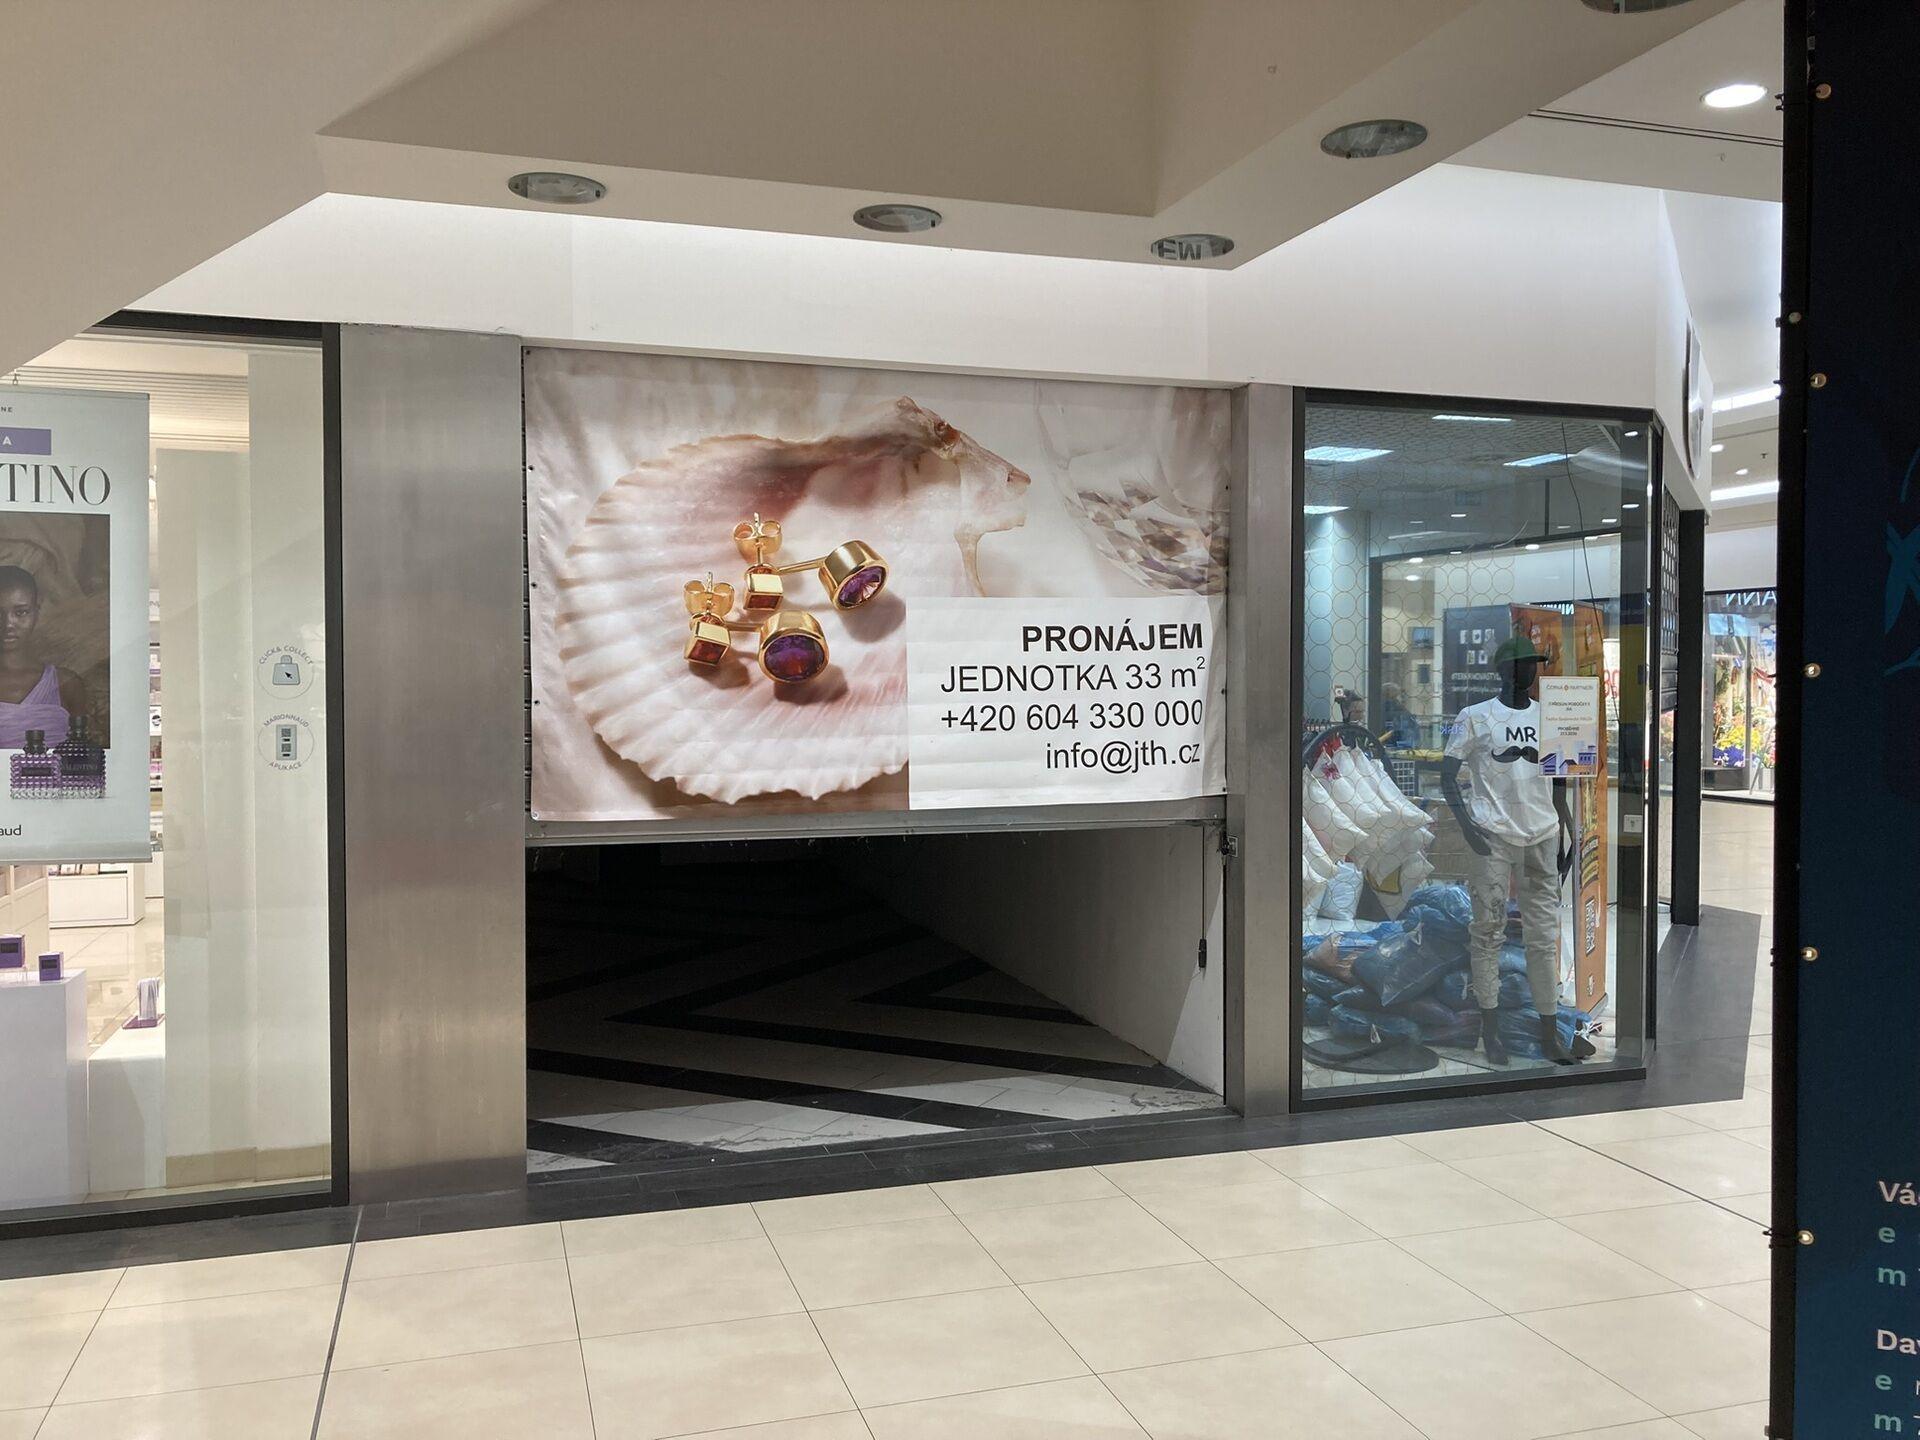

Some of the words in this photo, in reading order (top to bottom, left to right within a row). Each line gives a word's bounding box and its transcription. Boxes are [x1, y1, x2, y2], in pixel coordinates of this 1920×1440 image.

[0, 463, 111, 506] TINO
[1022, 618, 1203, 652] PRONÁJEM
[940, 664, 1118, 693] JEDNOTKA
[1125, 663, 1161, 690] 33
[941, 704, 1016, 732] +420
[1026, 703, 1079, 731] 604
[1089, 702, 1144, 729] 330
[1154, 700, 1202, 727] 000
[1506, 726, 1538, 743] MR
[1046, 739, 1201, 774] info@jth.cz
[1878, 1180, 1920, 1206] Vá
[1878, 1226, 1896, 1244] e
[1878, 1266, 1906, 1287] m
[1877, 1328, 1920, 1356] Da
[1874, 1374, 1893, 1391] e
[1873, 1413, 1902, 1433] m
